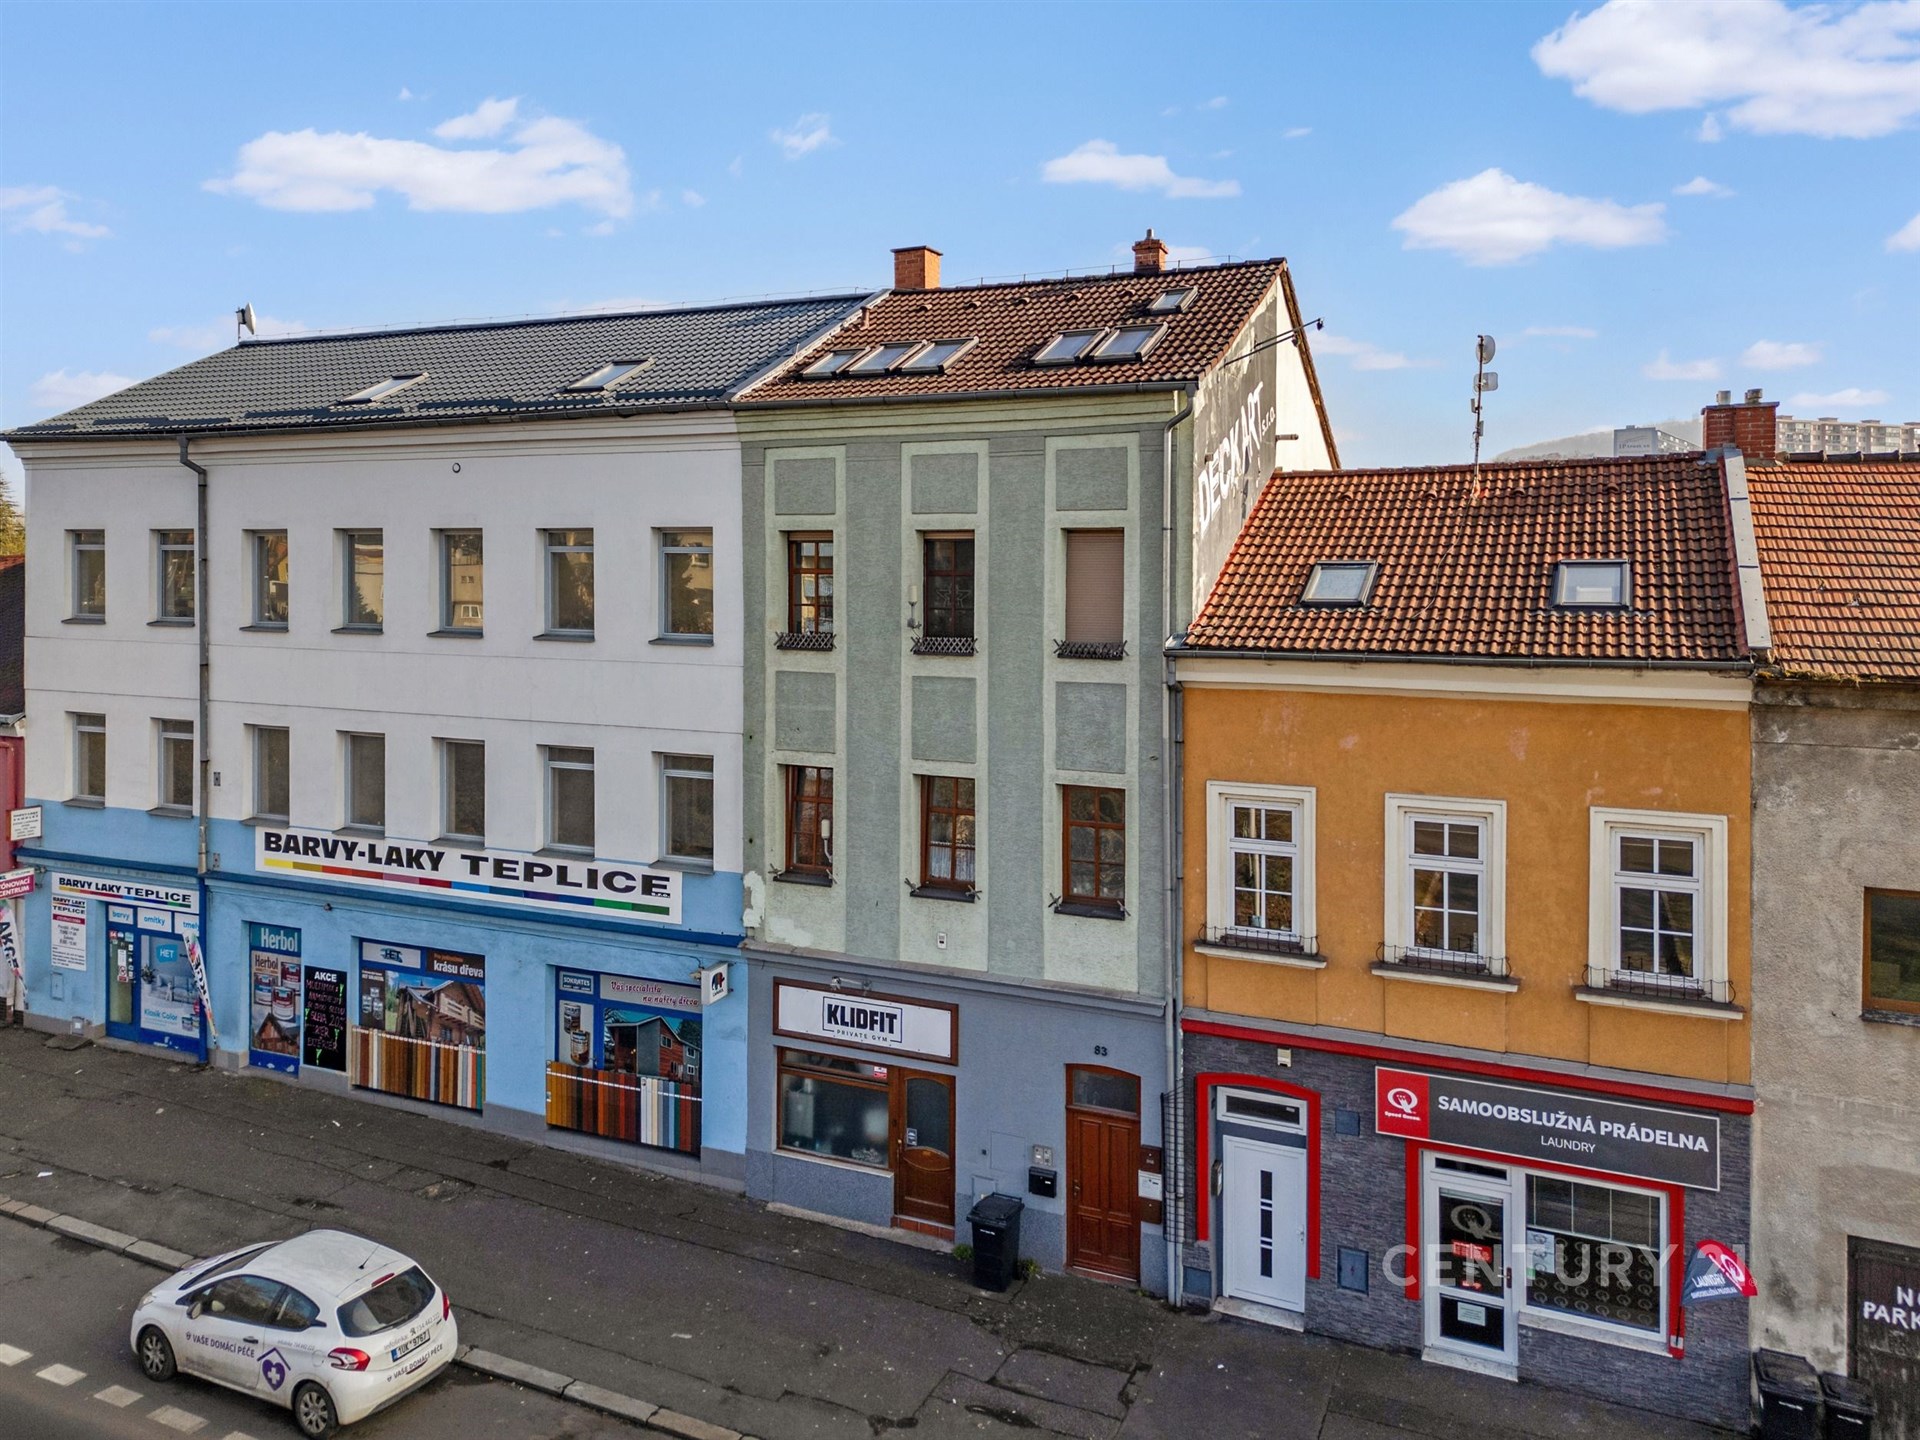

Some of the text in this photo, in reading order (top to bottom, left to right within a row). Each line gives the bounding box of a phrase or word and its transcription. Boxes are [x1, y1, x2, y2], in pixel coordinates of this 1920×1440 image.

[1198, 381, 1264, 539] DECKART
[264, 832, 670, 898] BARVY-LAKY TEPLICE
[0, 877, 30, 890] ÓNOVACÍ
[59, 877, 192, 903] BARVY LAKY TEPLICE
[53, 905, 85, 914] TEPLICE
[112, 910, 130, 921] barvy
[261, 927, 298, 952] Herbol
[160, 949, 174, 958] HET
[385, 949, 400, 960] HET
[255, 954, 278, 969] Herbol
[434, 960, 484, 978] krásu dřeva
[314, 971, 337, 982] AKCE
[563, 976, 591, 987] SOKRATES
[626, 983, 662, 994] specialista
[827, 1003, 898, 1034] KLIDFIT
[837, 1029, 888, 1042] PRIVATE GYM
[1094, 1045, 1108, 1056] 83
[1438, 1095, 1709, 1152] SAMOOBSLUŽNÁ PRÁDELNA
[1541, 1135, 1596, 1153] LAUNDRY
[1692, 1273, 1725, 1288] LAUNDRY
[1896, 1286, 1920, 1307] N
[193, 1334, 255, 1358] VAŠE DOMÁCÍ PÉČE
[412, 1331, 427, 1347] 9767
[393, 1343, 443, 1379] VAŠE DOMÁCÍ PÉČE
